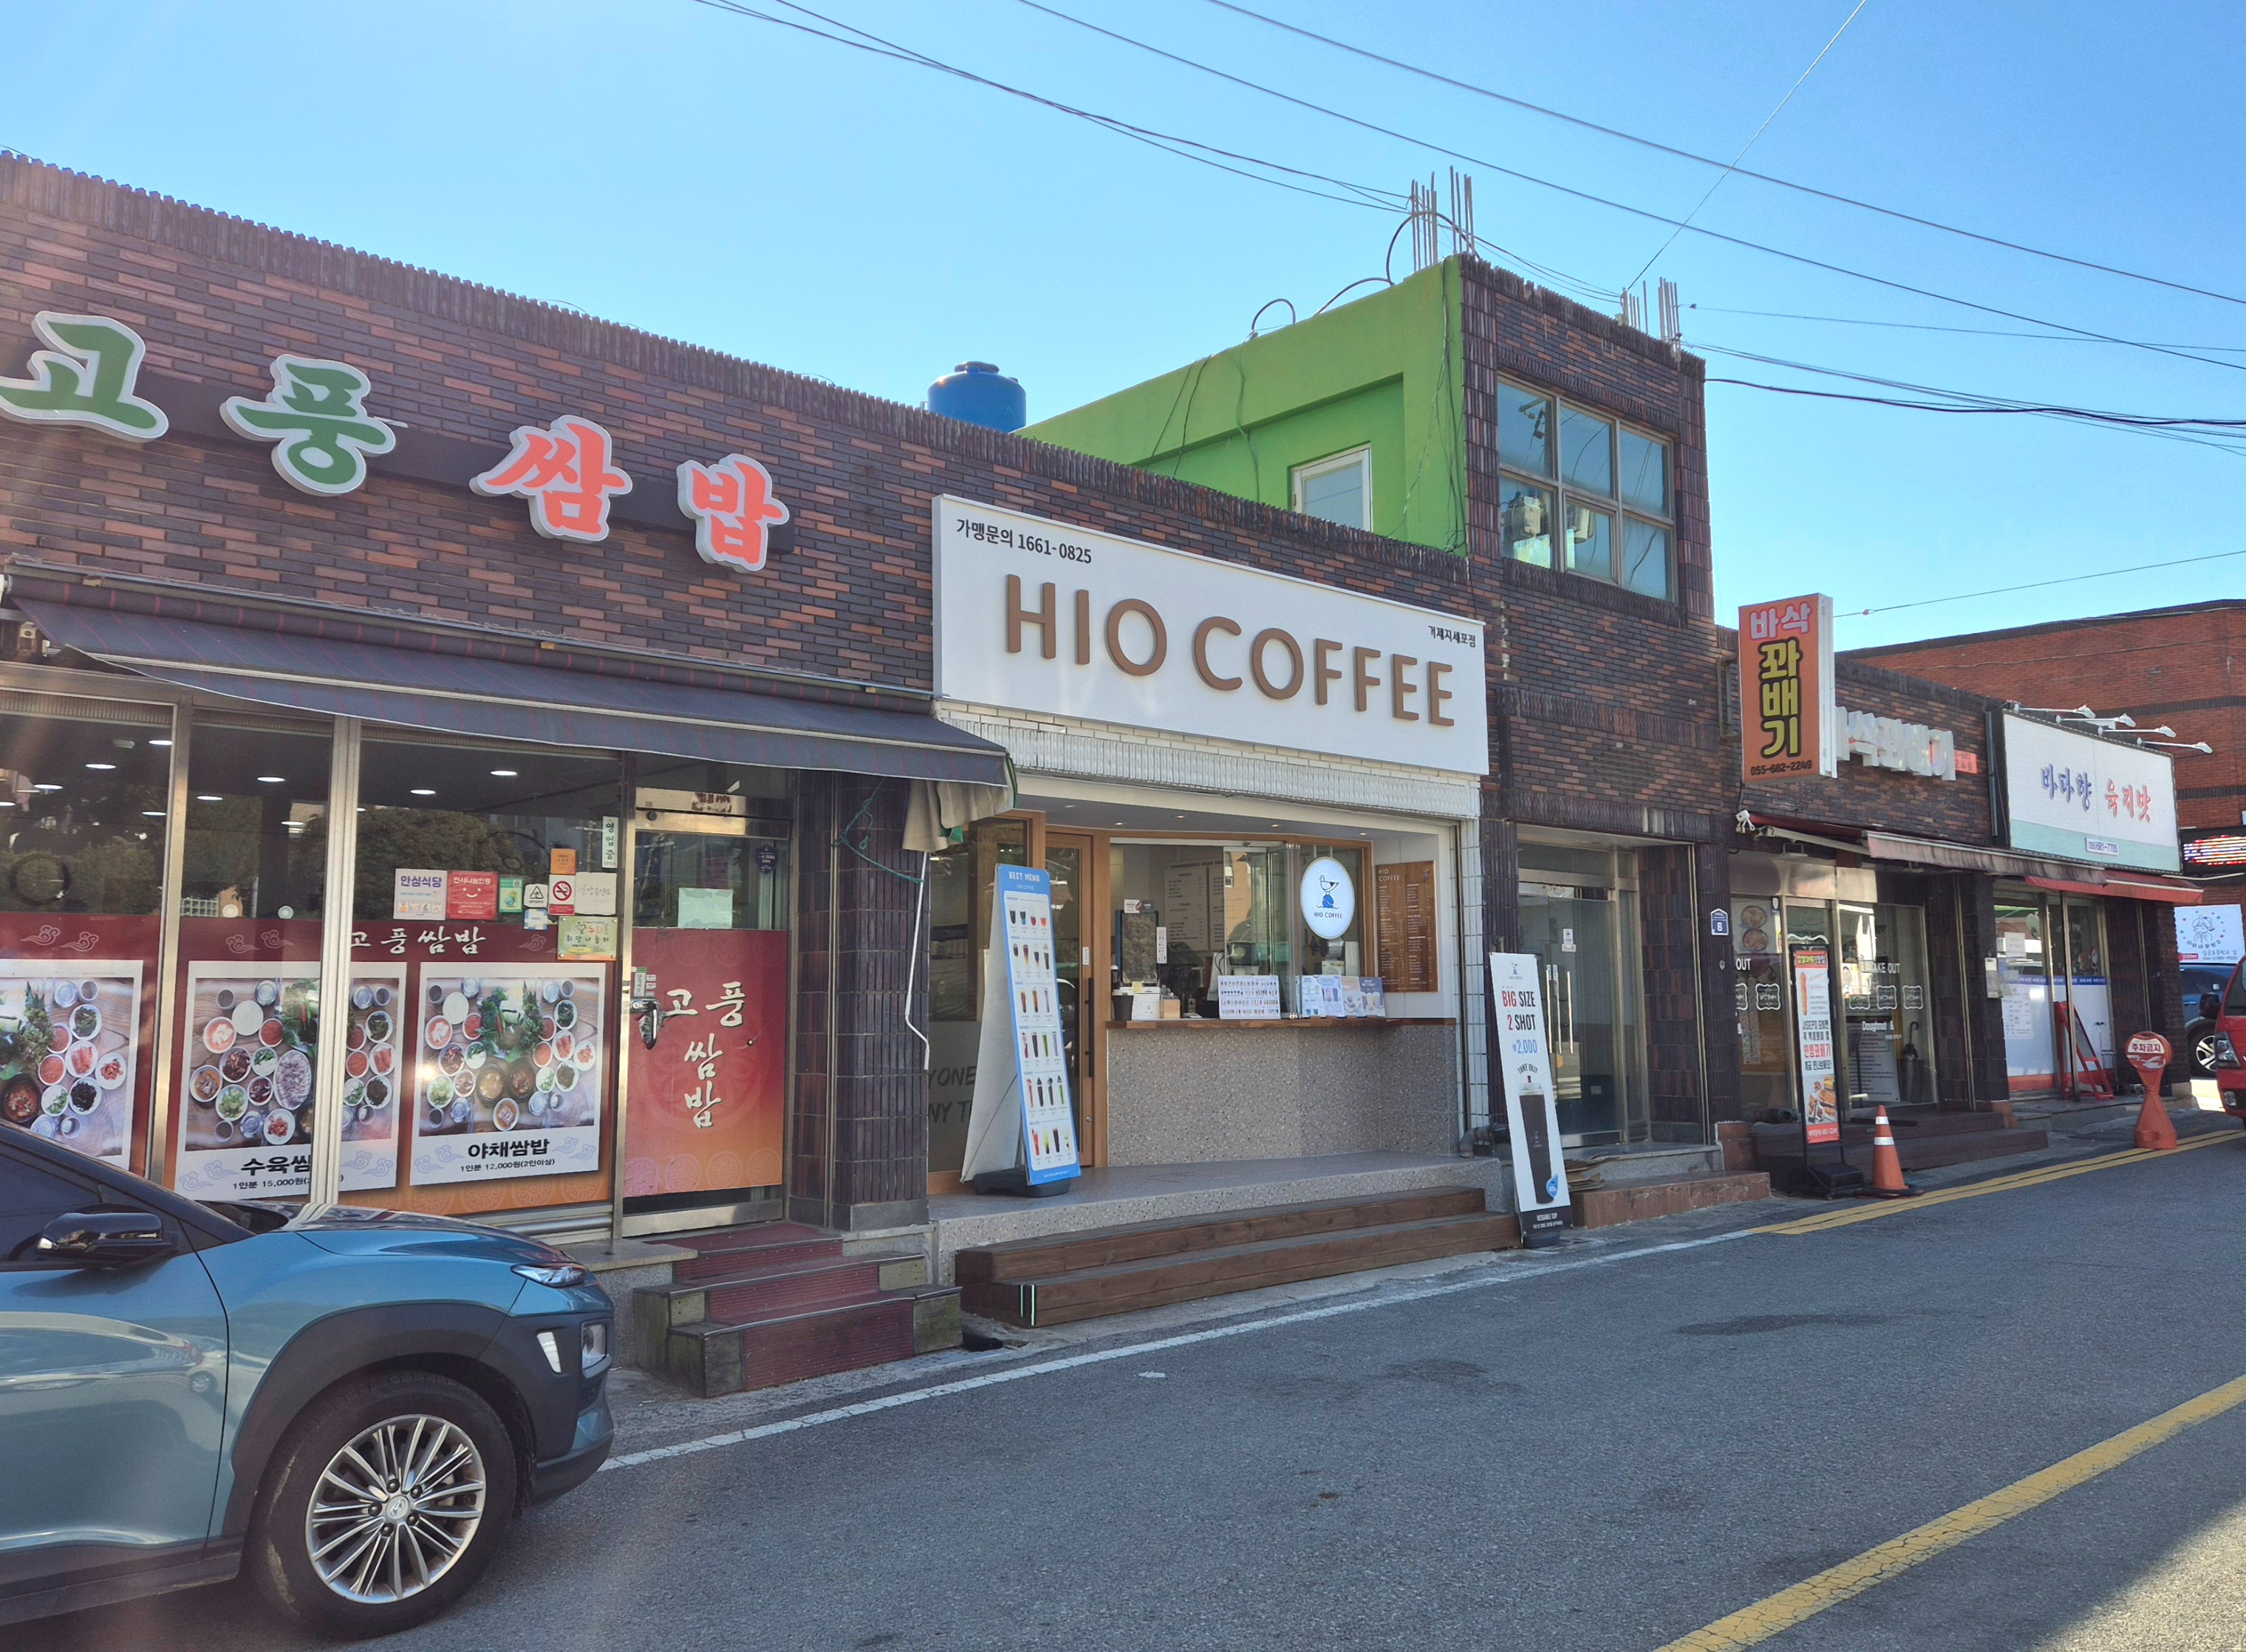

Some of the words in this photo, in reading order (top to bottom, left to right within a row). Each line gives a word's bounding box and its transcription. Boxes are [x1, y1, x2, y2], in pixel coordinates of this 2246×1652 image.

[957, 519, 1013, 548] 가맹문의
[1018, 533, 1091, 564] 1661-0825
[1750, 603, 1811, 640] 바삭
[1428, 626, 1475, 647] 거제지세포점
[1006, 574, 1167, 677] HIO
[1192, 616, 1455, 726] COFFEE
[1760, 638, 1801, 756] 꽈배기
[1751, 760, 1812, 776] 055-682-2249
[2041, 763, 2092, 812] 바다향
[2105, 778, 2151, 823] 육지맛
[605, 822, 615, 860] 영업중
[400, 876, 443, 887] 안심식당
[1008, 872, 1023, 880] BEST
[1718, 922, 1722, 931] 8
[1736, 958, 1751, 970] OUT
[1872, 963, 1886, 973] AKE
[1888, 963, 1900, 974] OUT
[663, 981, 745, 1026] 고풍
[1502, 991, 1517, 1007] BIG
[1519, 991, 1536, 1008] SIZE
[1507, 1014, 1513, 1031] 2
[1515, 1014, 1536, 1031] SHOT
[2131, 1043, 2161, 1052] 주차금지
[468, 1139, 550, 1159] 야채쌈밥
[233, 1180, 258, 1189] 1인분
